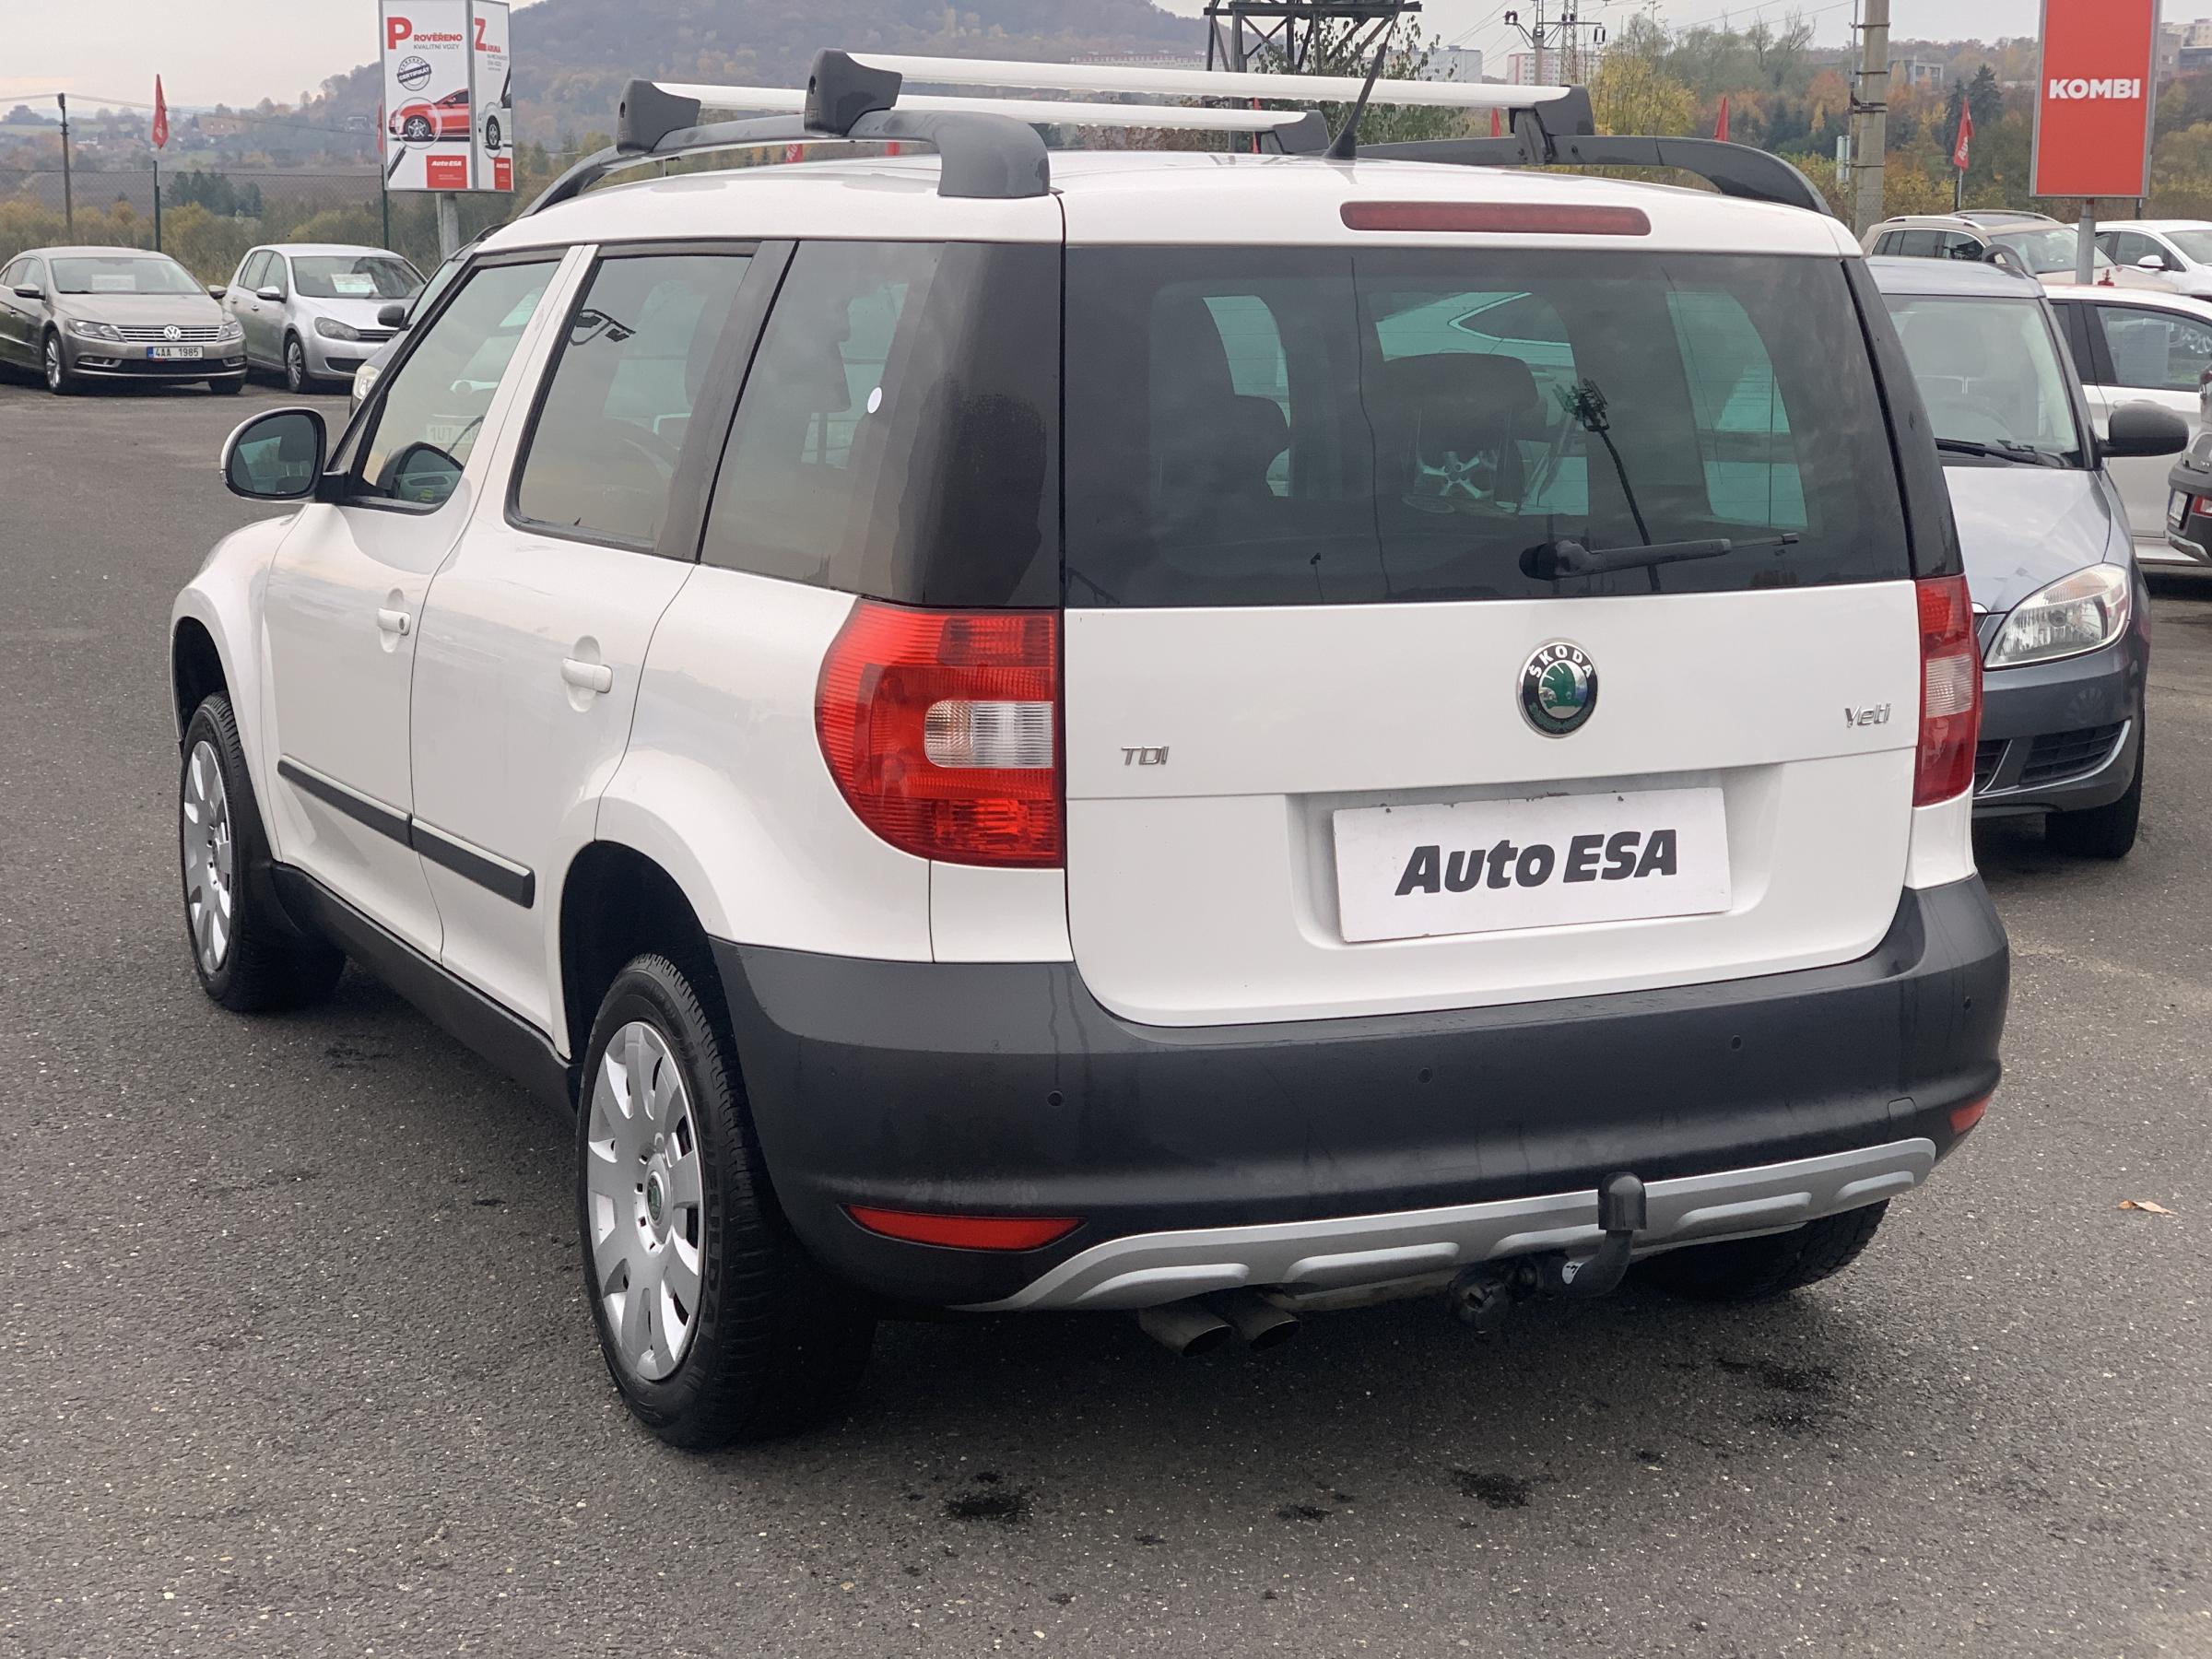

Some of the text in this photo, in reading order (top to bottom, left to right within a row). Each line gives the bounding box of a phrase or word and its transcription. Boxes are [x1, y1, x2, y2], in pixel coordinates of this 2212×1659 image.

[2049, 78, 2141, 100] KOMBI
[156, 347, 199, 357] 4AA 1985
[1527, 645, 1593, 678] ŠKODA
[1844, 702, 1891, 728] Yeti
[1121, 746, 1170, 766] TDI
[1394, 829, 1677, 896] Auto ESA
